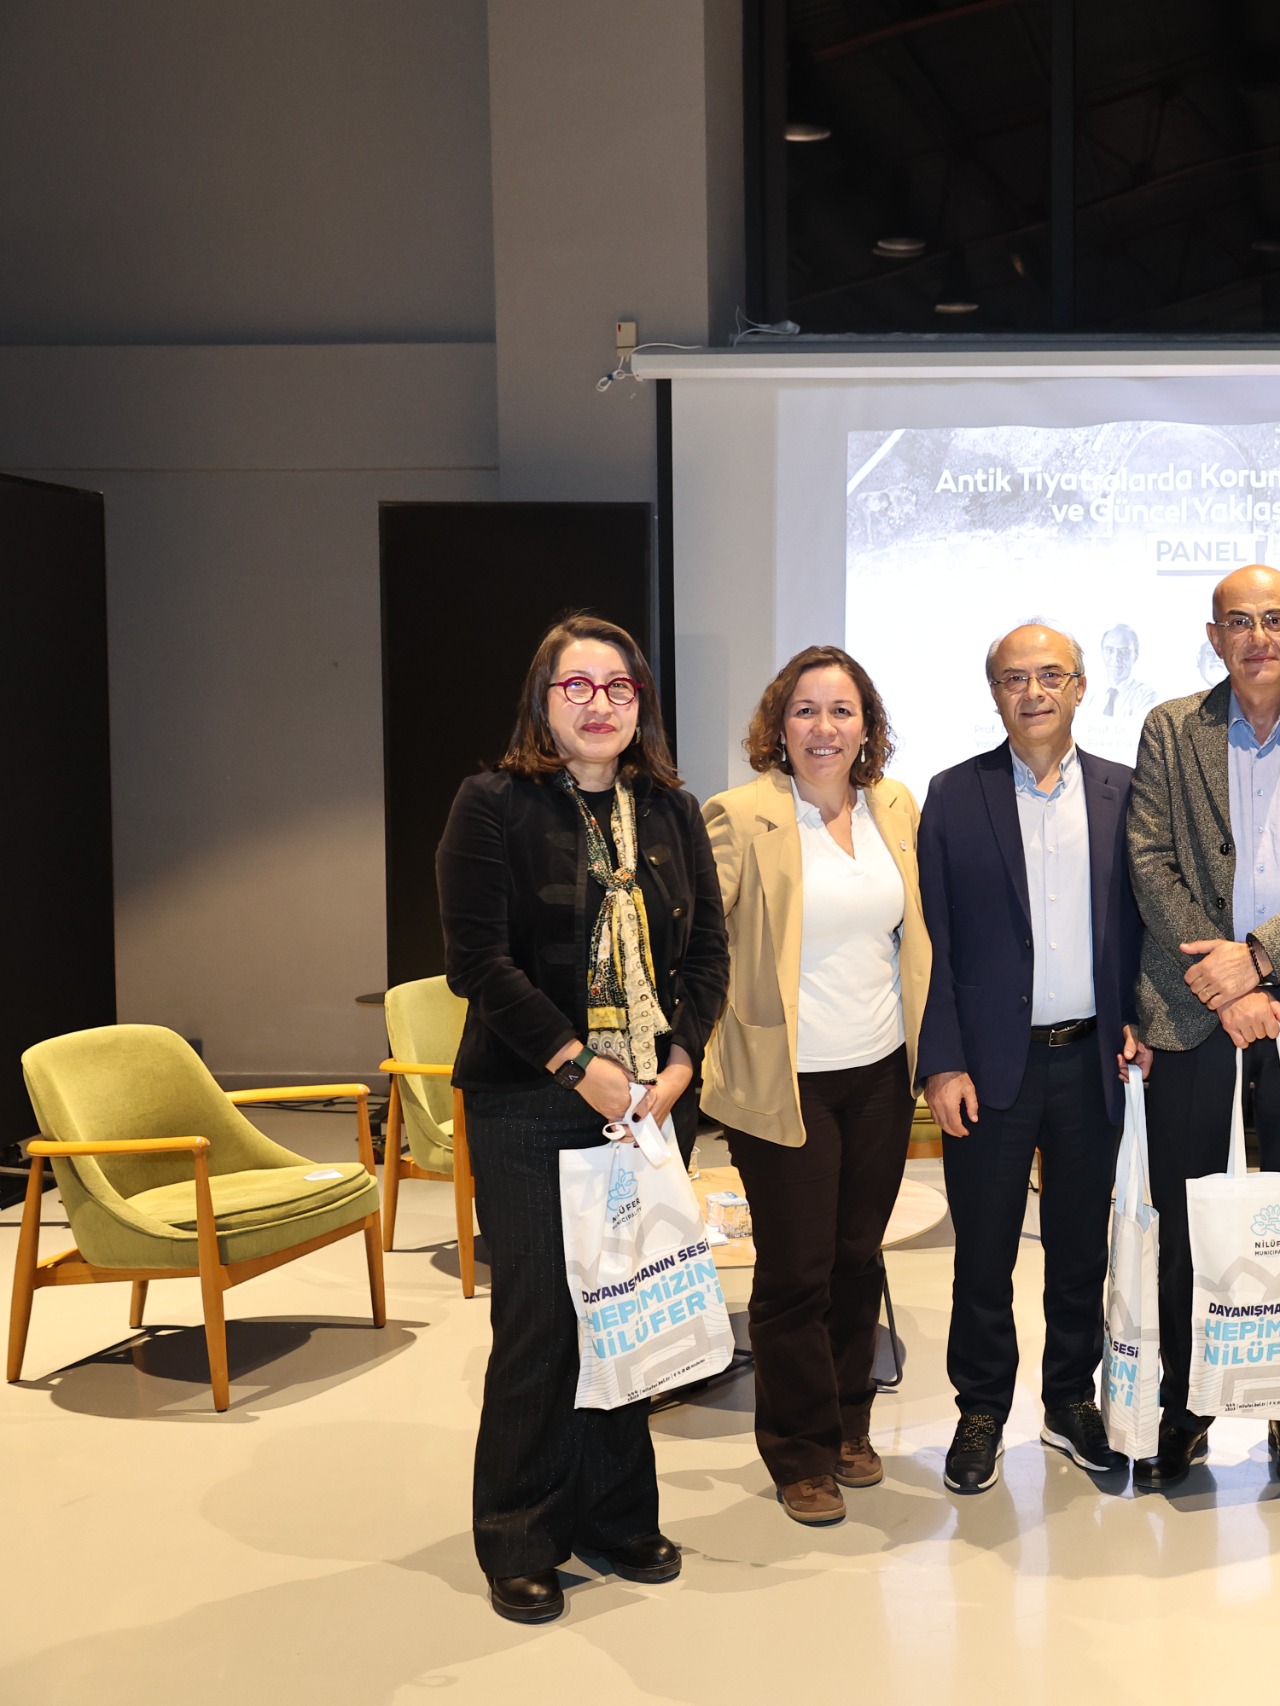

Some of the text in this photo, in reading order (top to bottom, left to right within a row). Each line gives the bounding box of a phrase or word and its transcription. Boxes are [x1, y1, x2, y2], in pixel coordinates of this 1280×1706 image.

[935, 467, 1011, 493] Antik
[1017, 463, 1192, 498] Tiyatrolarda
[1051, 503, 1084, 523] ve
[1089, 497, 1188, 523] Güncel
[1156, 540, 1248, 562] PANEL
